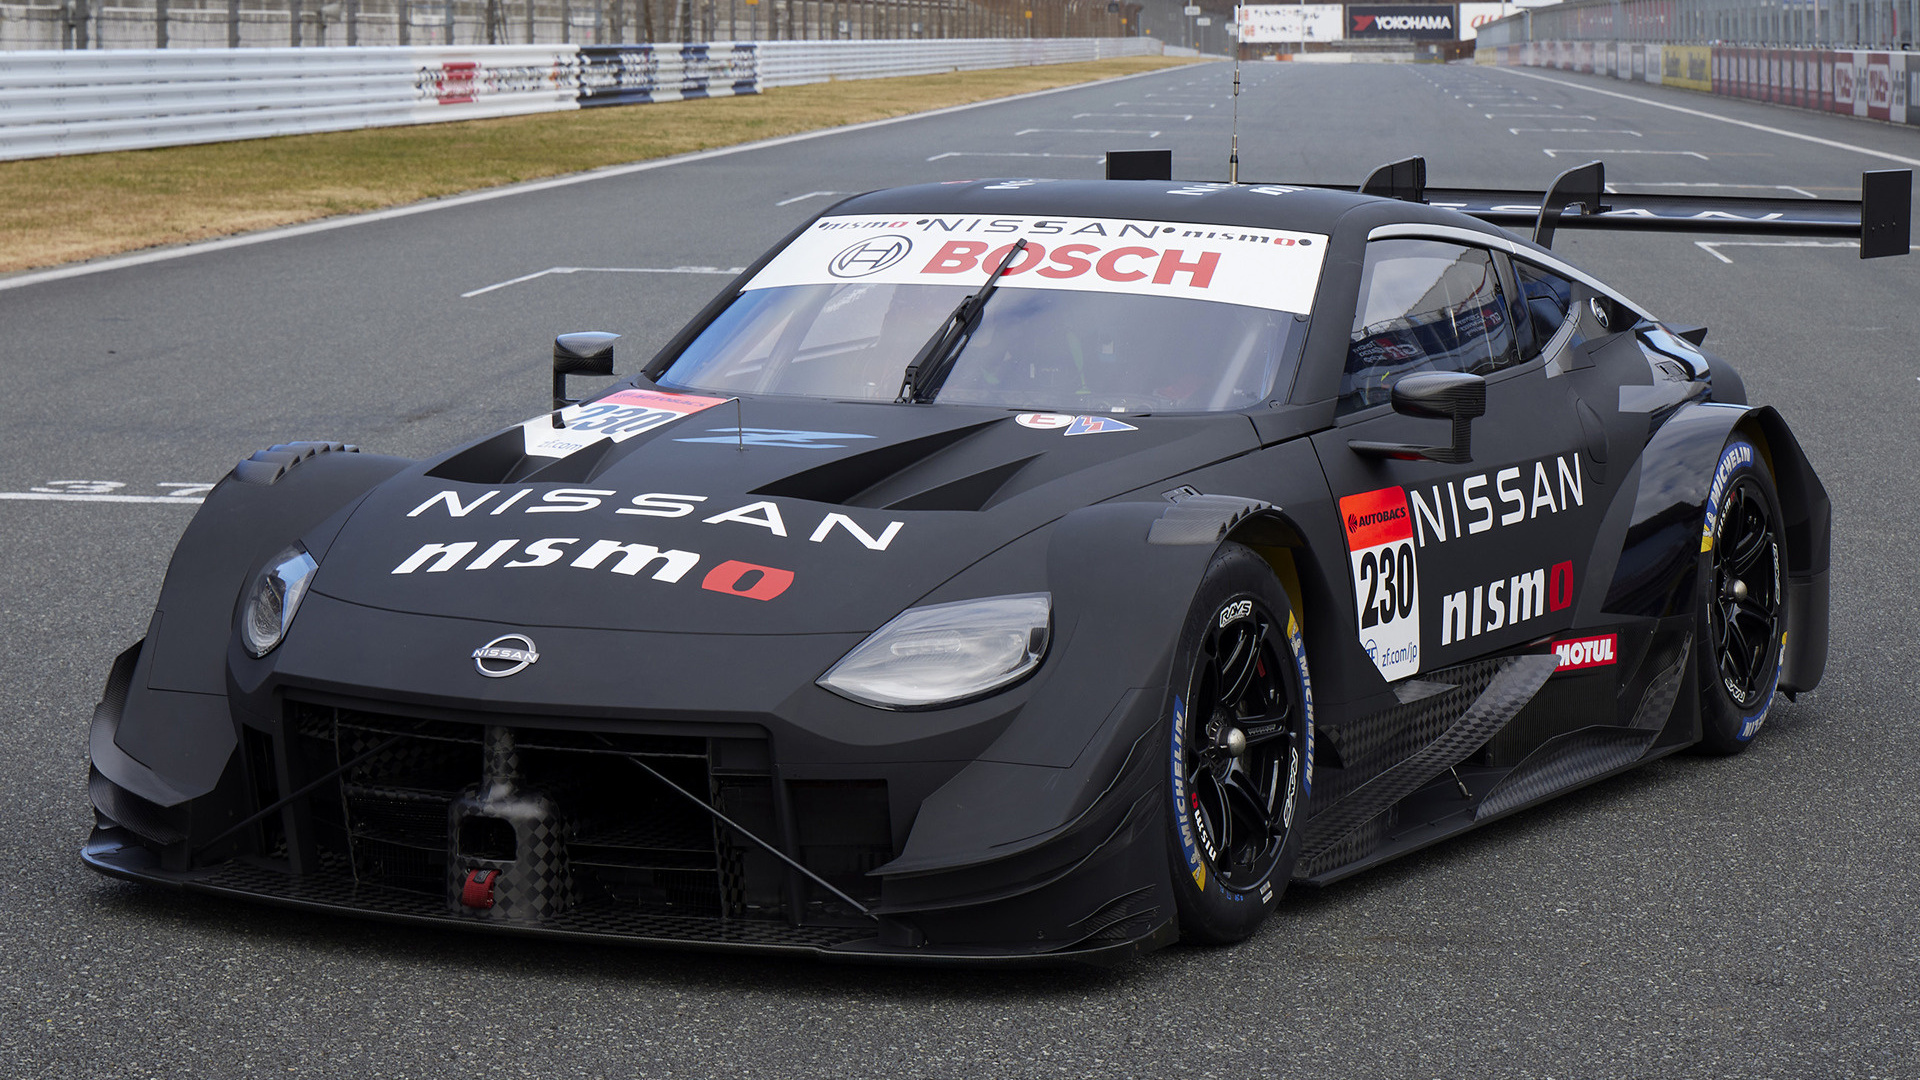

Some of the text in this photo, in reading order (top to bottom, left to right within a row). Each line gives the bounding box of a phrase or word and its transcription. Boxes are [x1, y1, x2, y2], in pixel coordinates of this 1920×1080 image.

[1374, 15, 1452, 30] YOKOHAMA
[822, 218, 1296, 246] nismo NISSAN nismo
[919, 240, 1222, 289] BOSCH
[1410, 452, 1584, 548] NISSAN
[1710, 446, 1751, 510] MICHELIN
[406, 488, 904, 551] NISSAN
[1358, 506, 1406, 528] AUTOBACS
[390, 537, 795, 601] nismo
[1360, 542, 1414, 631] 230
[1220, 600, 1252, 628] RAYS
[1441, 560, 1574, 646] nismo
[473, 649, 537, 662] NISSAN
[1382, 641, 1418, 667] zf.com/jp
[1556, 638, 1614, 667] MOTUL
[1299, 654, 1315, 786] MICHELIN
[1174, 709, 1194, 849] MICHELIN
[1191, 791, 1218, 863] nismo
